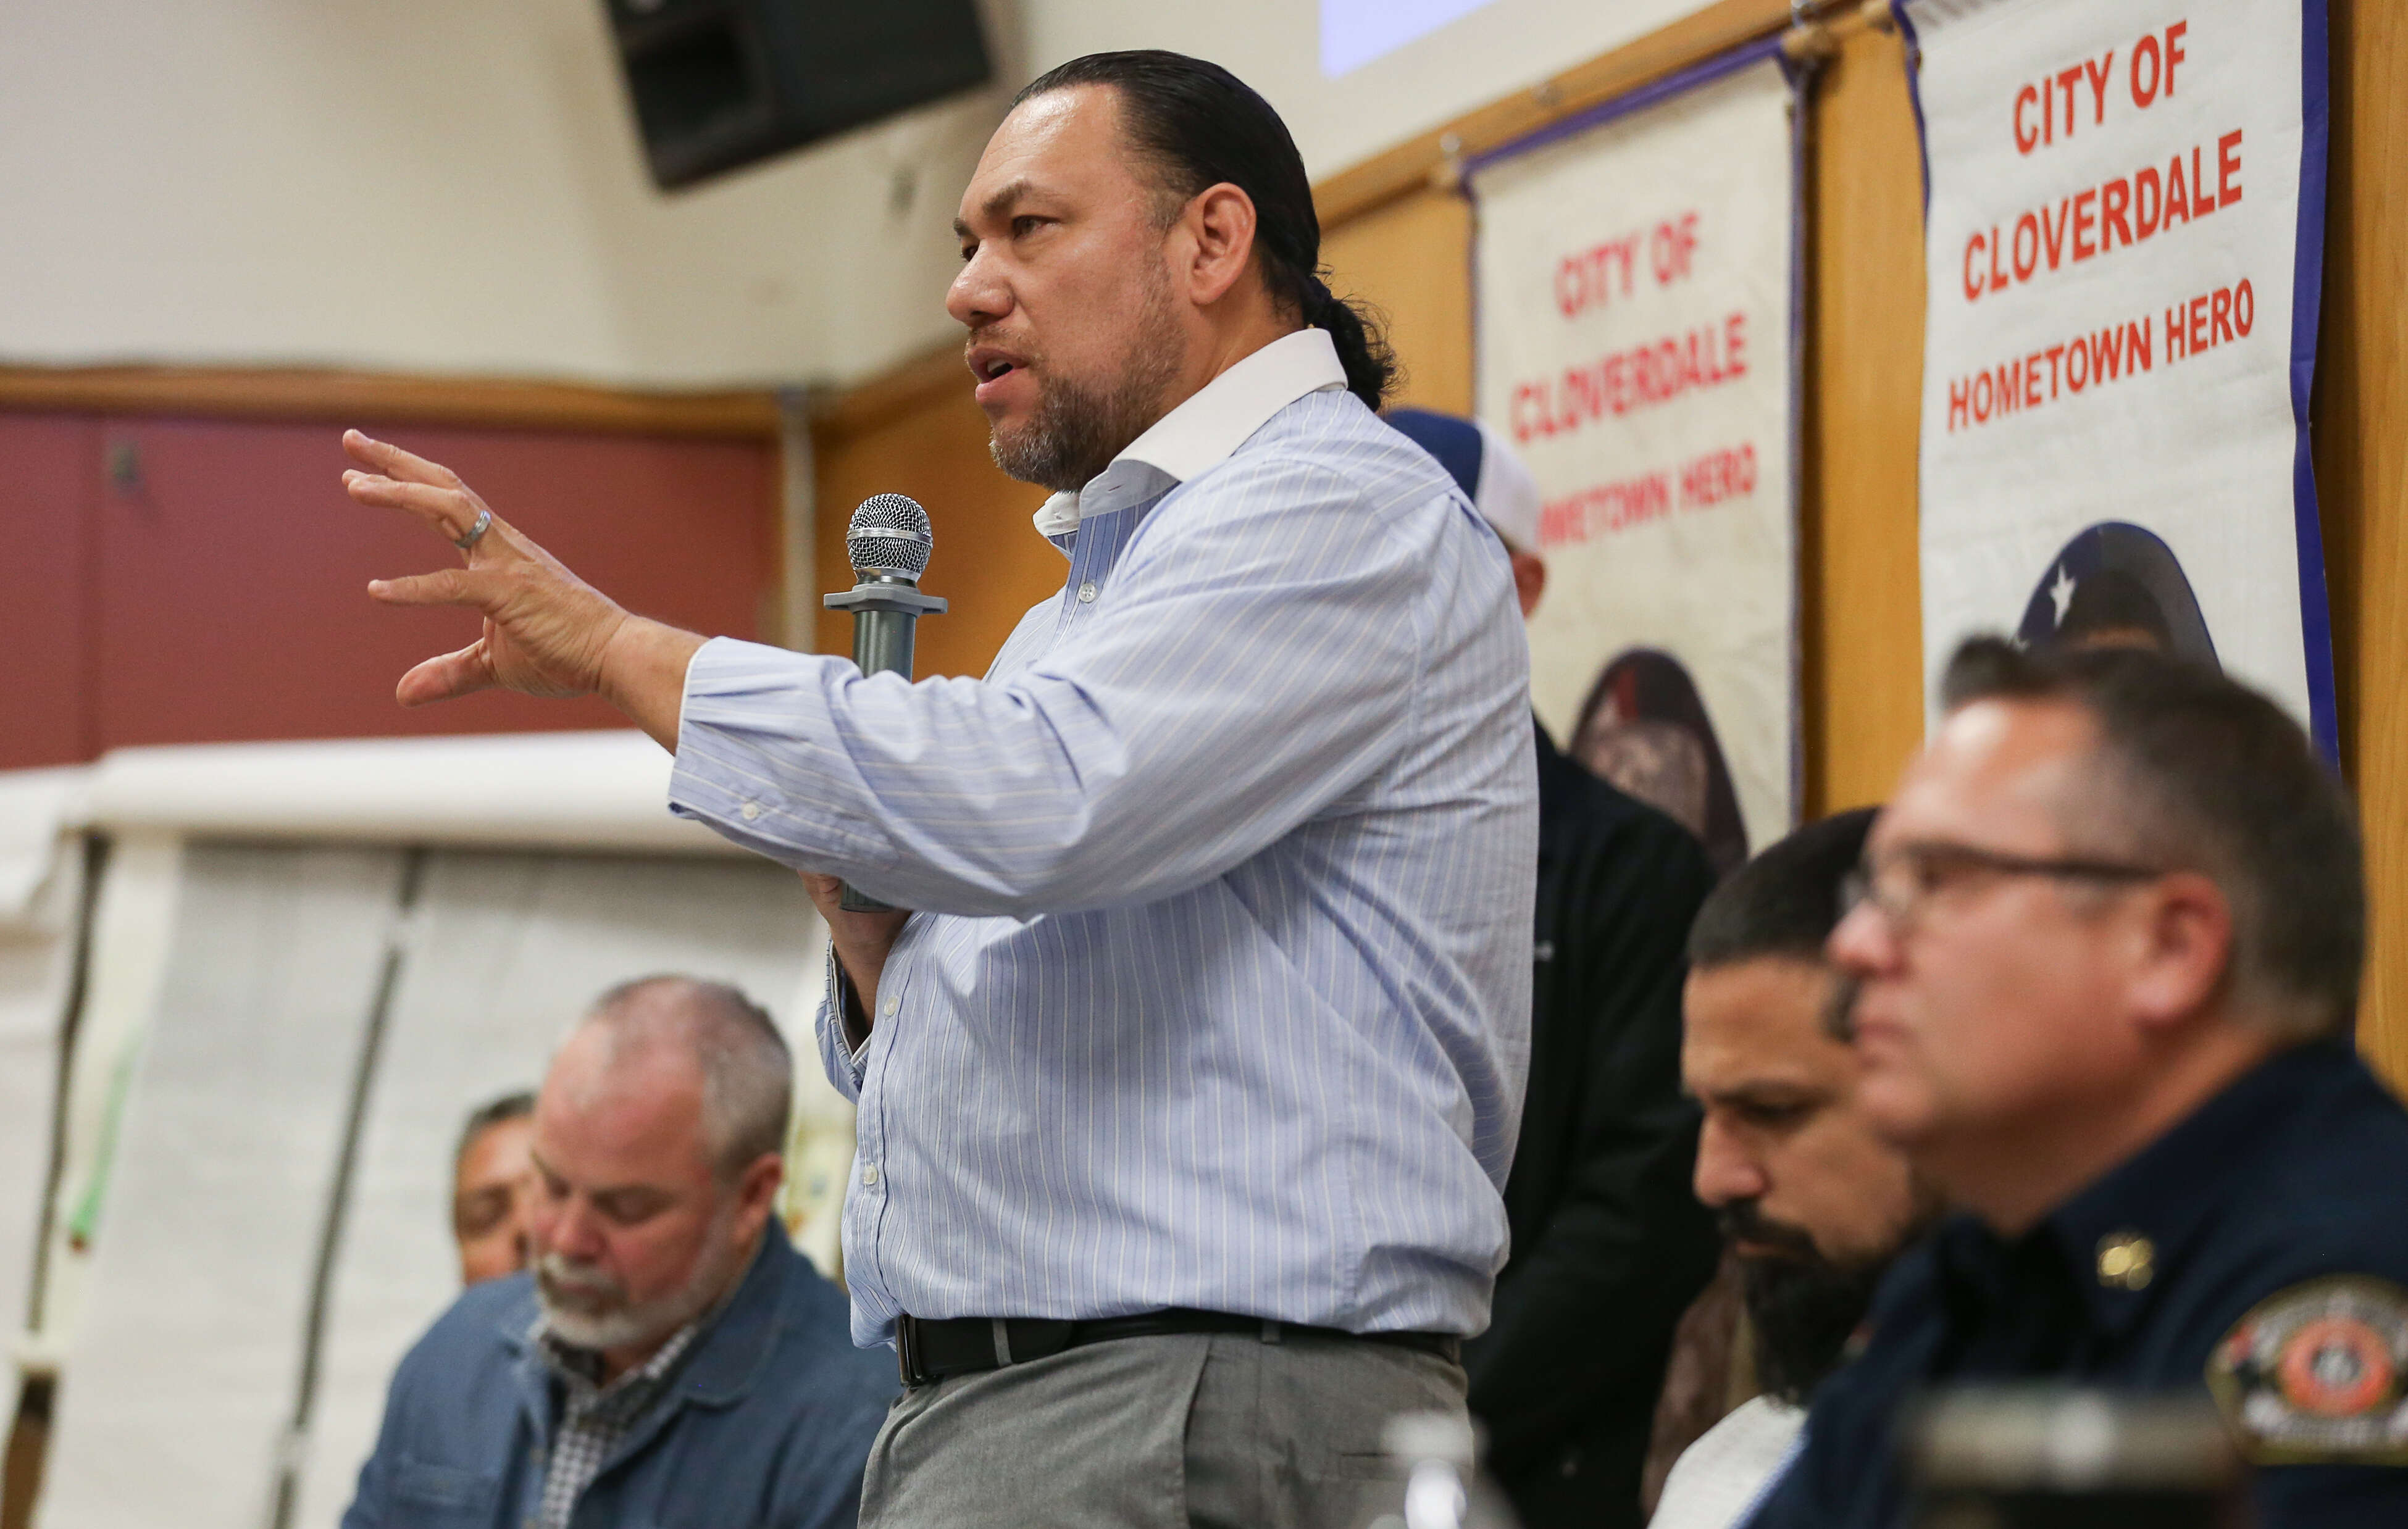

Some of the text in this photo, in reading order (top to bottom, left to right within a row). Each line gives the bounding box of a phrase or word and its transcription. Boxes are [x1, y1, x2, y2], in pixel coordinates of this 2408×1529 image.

[2013, 20, 2186, 156] CITY OF
[1555, 210, 1699, 319] CITY OF
[1962, 128, 2242, 304] CLOVERDALE
[1511, 311, 1747, 443] CLOVERDALE
[1948, 278, 2254, 432] HOMETOWN HERO
[1537, 443, 1757, 548] METOWN HERO
